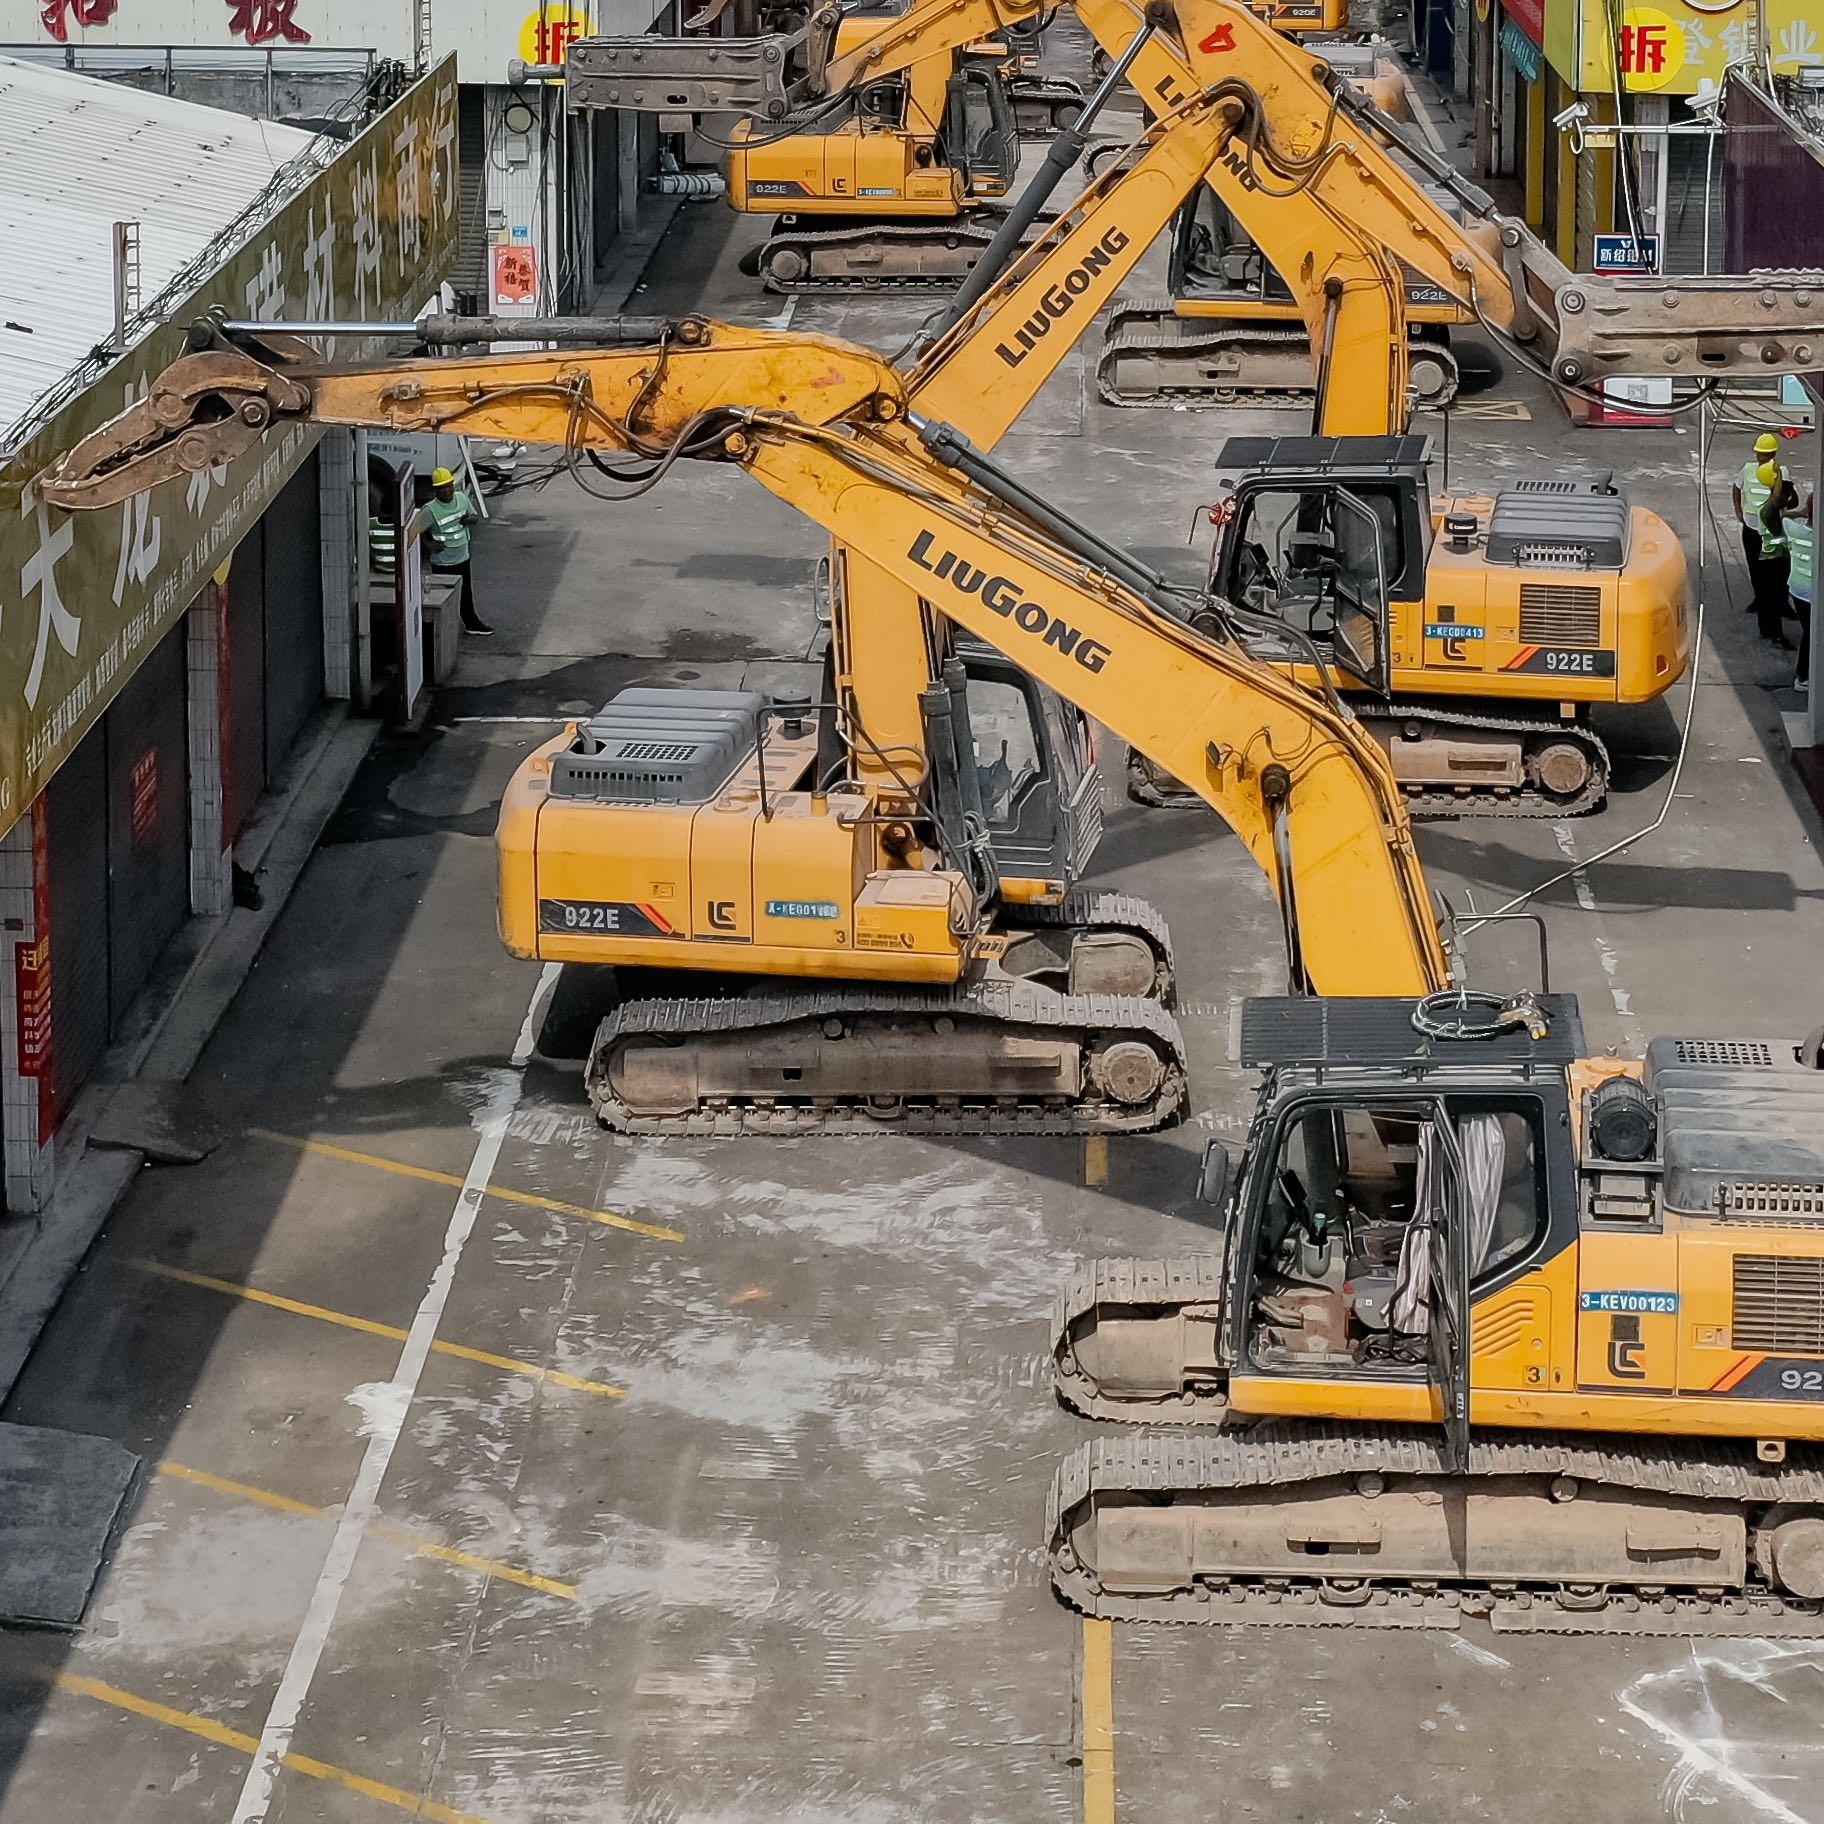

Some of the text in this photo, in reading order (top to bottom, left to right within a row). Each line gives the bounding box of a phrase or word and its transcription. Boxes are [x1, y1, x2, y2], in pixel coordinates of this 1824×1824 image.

[1619, 24, 1667, 74] 拆
[993, 225, 1131, 370] LIUGONG
[906, 529, 1113, 675] LIUGONG
[1545, 651, 1594, 672] 922E
[564, 906, 621, 929] 922E
[1580, 1292, 1676, 1313] 3-KEV00123
